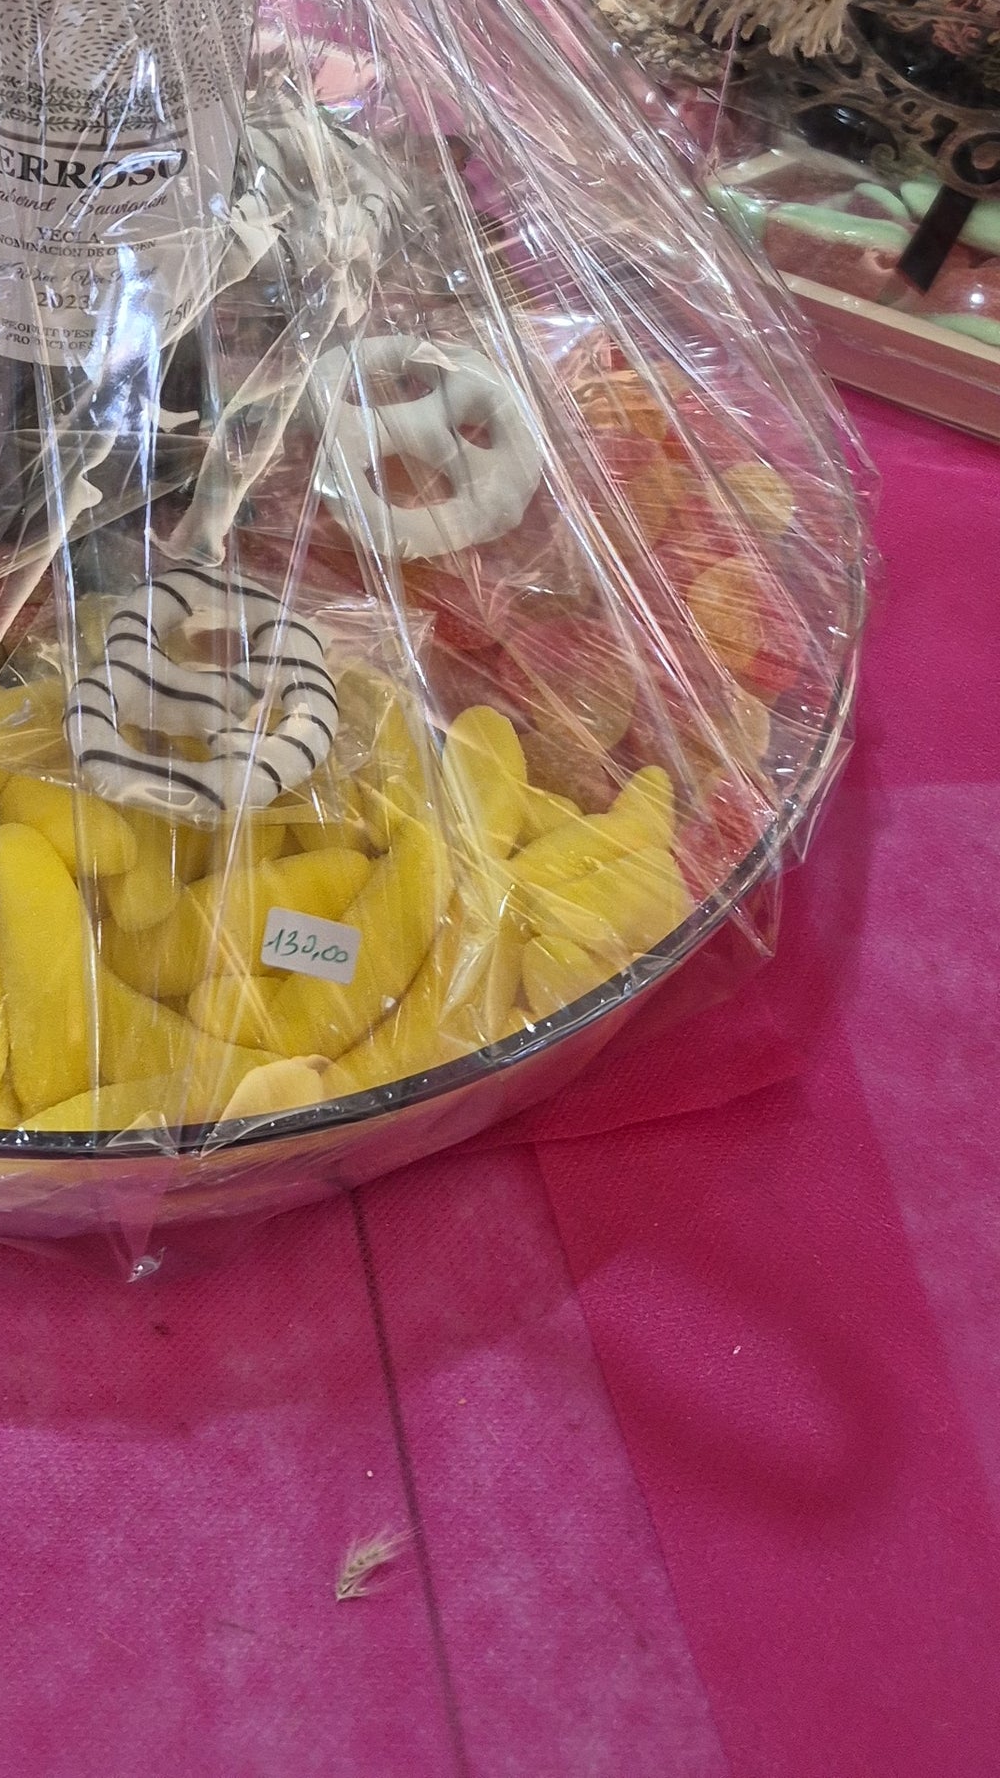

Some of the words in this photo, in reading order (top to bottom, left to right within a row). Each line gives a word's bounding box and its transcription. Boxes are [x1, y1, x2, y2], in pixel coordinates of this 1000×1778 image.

[87, 247, 105, 258] DE
[37, 292, 92, 310] 2023
[263, 928, 348, 963] 130,00
